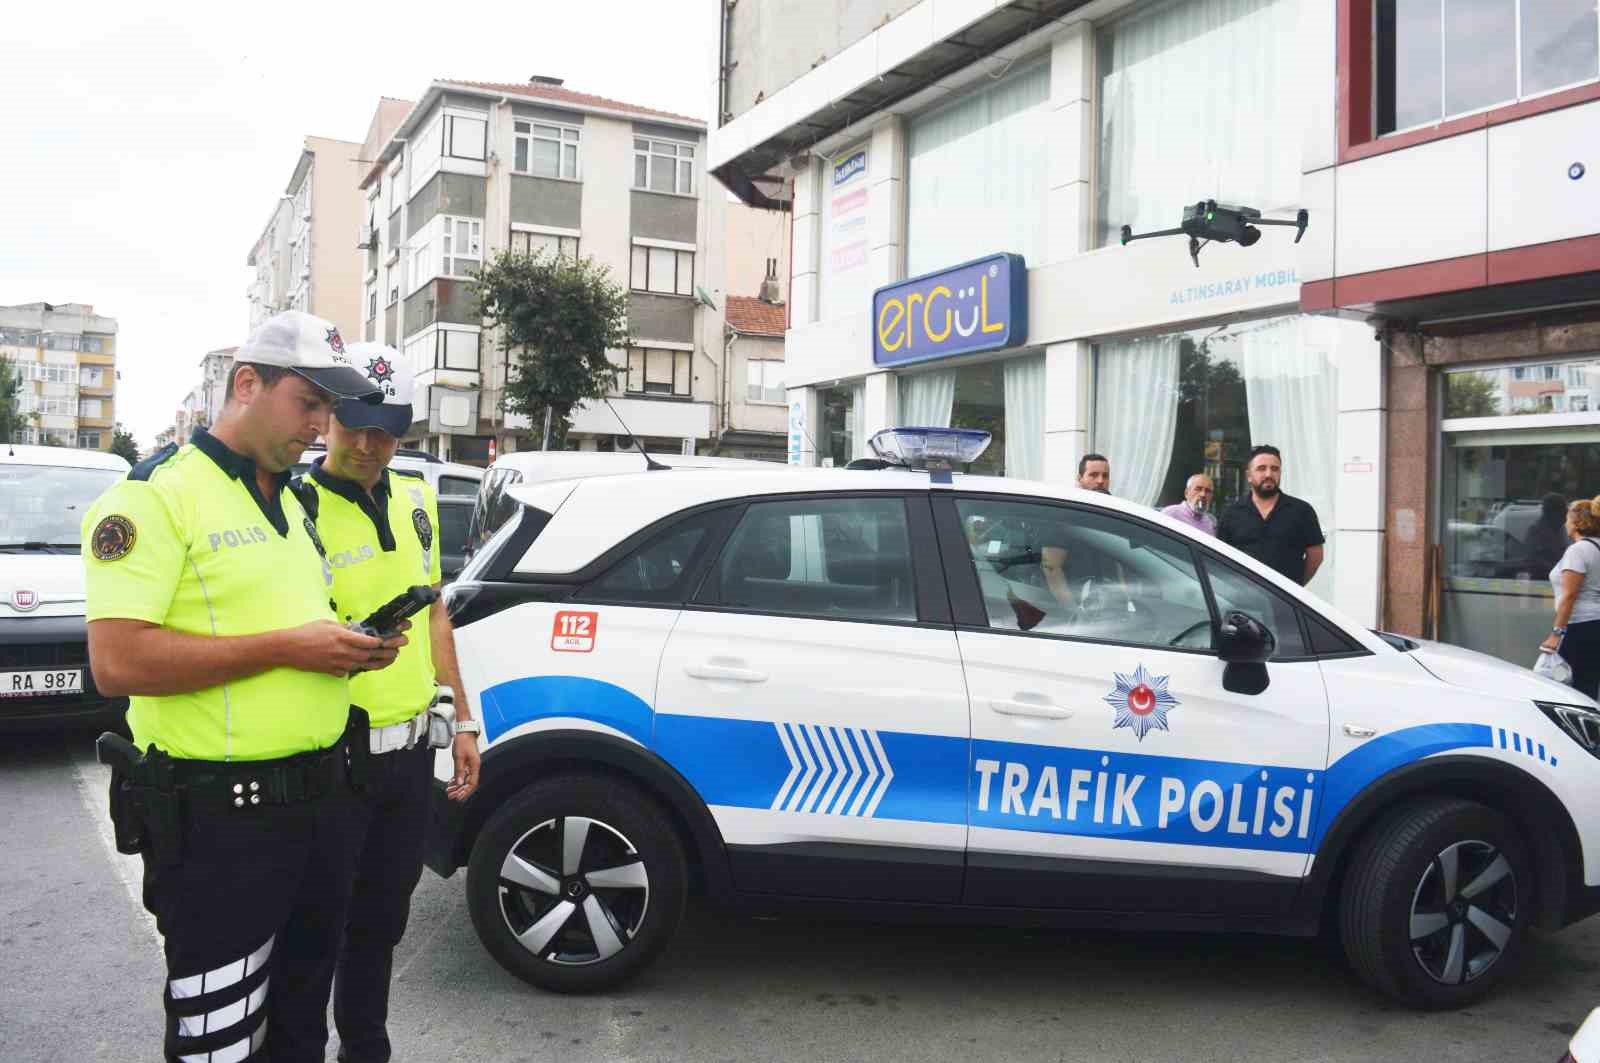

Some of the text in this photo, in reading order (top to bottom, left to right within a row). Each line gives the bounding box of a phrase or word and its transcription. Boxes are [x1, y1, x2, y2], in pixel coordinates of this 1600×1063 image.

[1169, 276, 1251, 304] ALTINSARAY
[329, 544, 374, 568] OLİS
[561, 616, 591, 635] 112
[13, 672, 77, 690] RA 987
[975, 755, 1314, 838] TRAFİK POLİSİ
